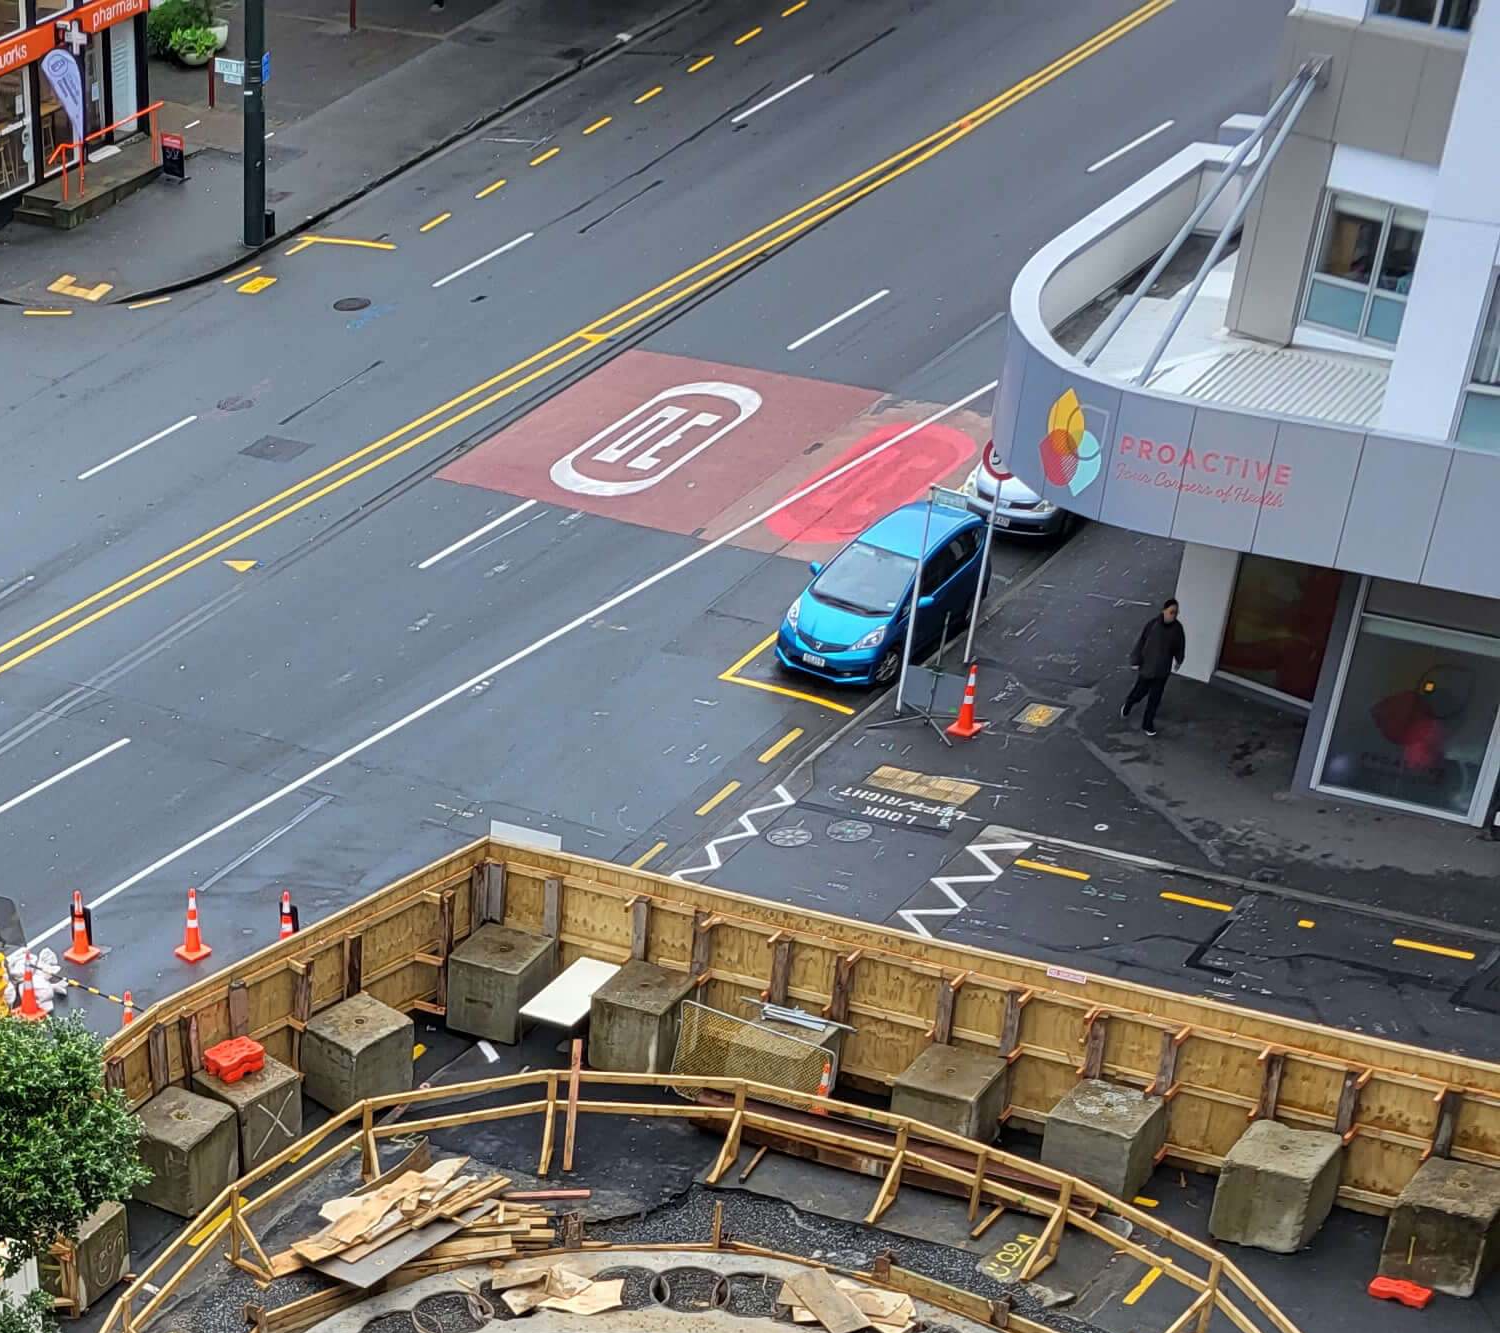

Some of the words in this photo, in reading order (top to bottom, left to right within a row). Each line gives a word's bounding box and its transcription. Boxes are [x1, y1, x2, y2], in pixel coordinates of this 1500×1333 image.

[92, 0, 145, 31] pharmacy
[1119, 435, 1292, 486] PROACTIVE
[860, 805, 918, 826] LOOK
